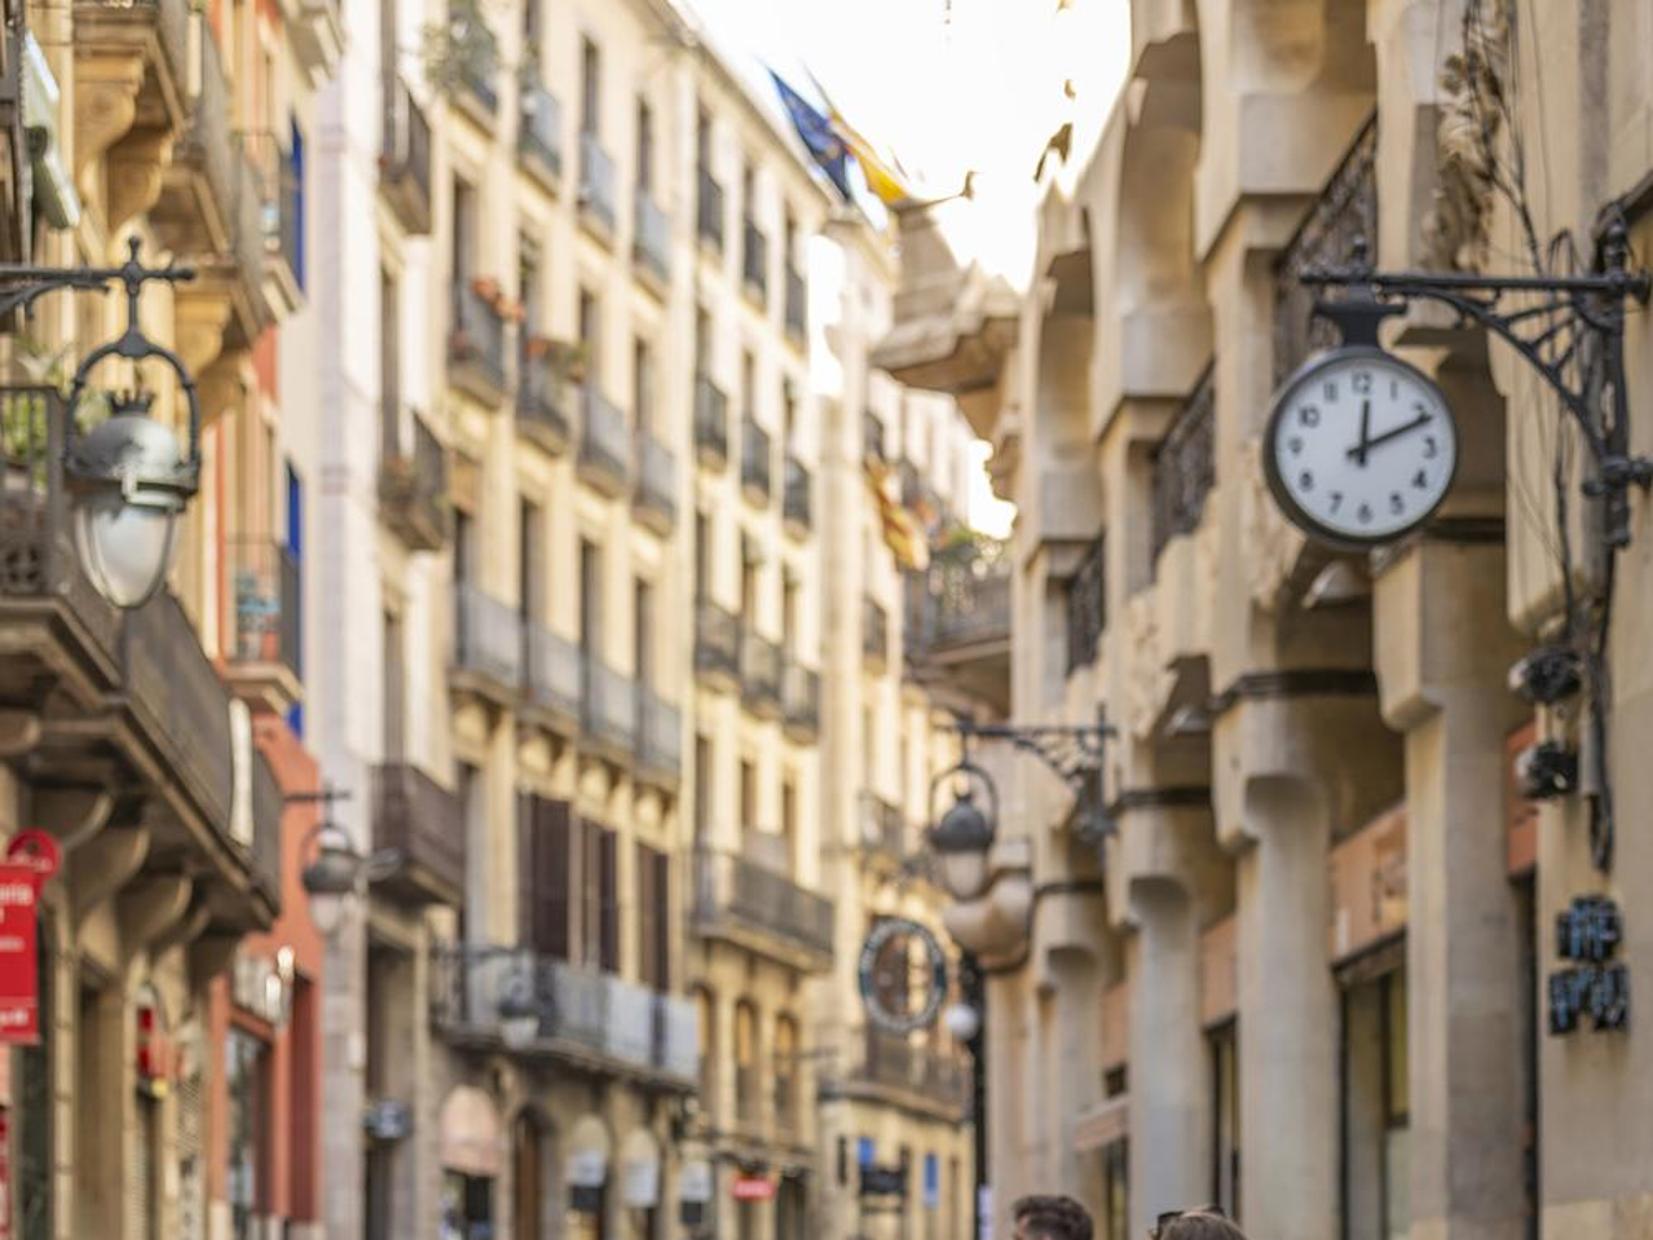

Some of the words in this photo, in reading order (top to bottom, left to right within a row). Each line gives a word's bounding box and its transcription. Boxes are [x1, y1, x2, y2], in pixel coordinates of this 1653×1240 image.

[1351, 371, 1373, 395] 12
[1299, 406, 1320, 428] 10
[1423, 436, 1438, 459] 3
[1299, 469, 1314, 491] 8
[1412, 469, 1428, 489] 4
[1329, 491, 1344, 515] 7
[1356, 502, 1373, 524] 6
[1390, 490, 1404, 515] 5
